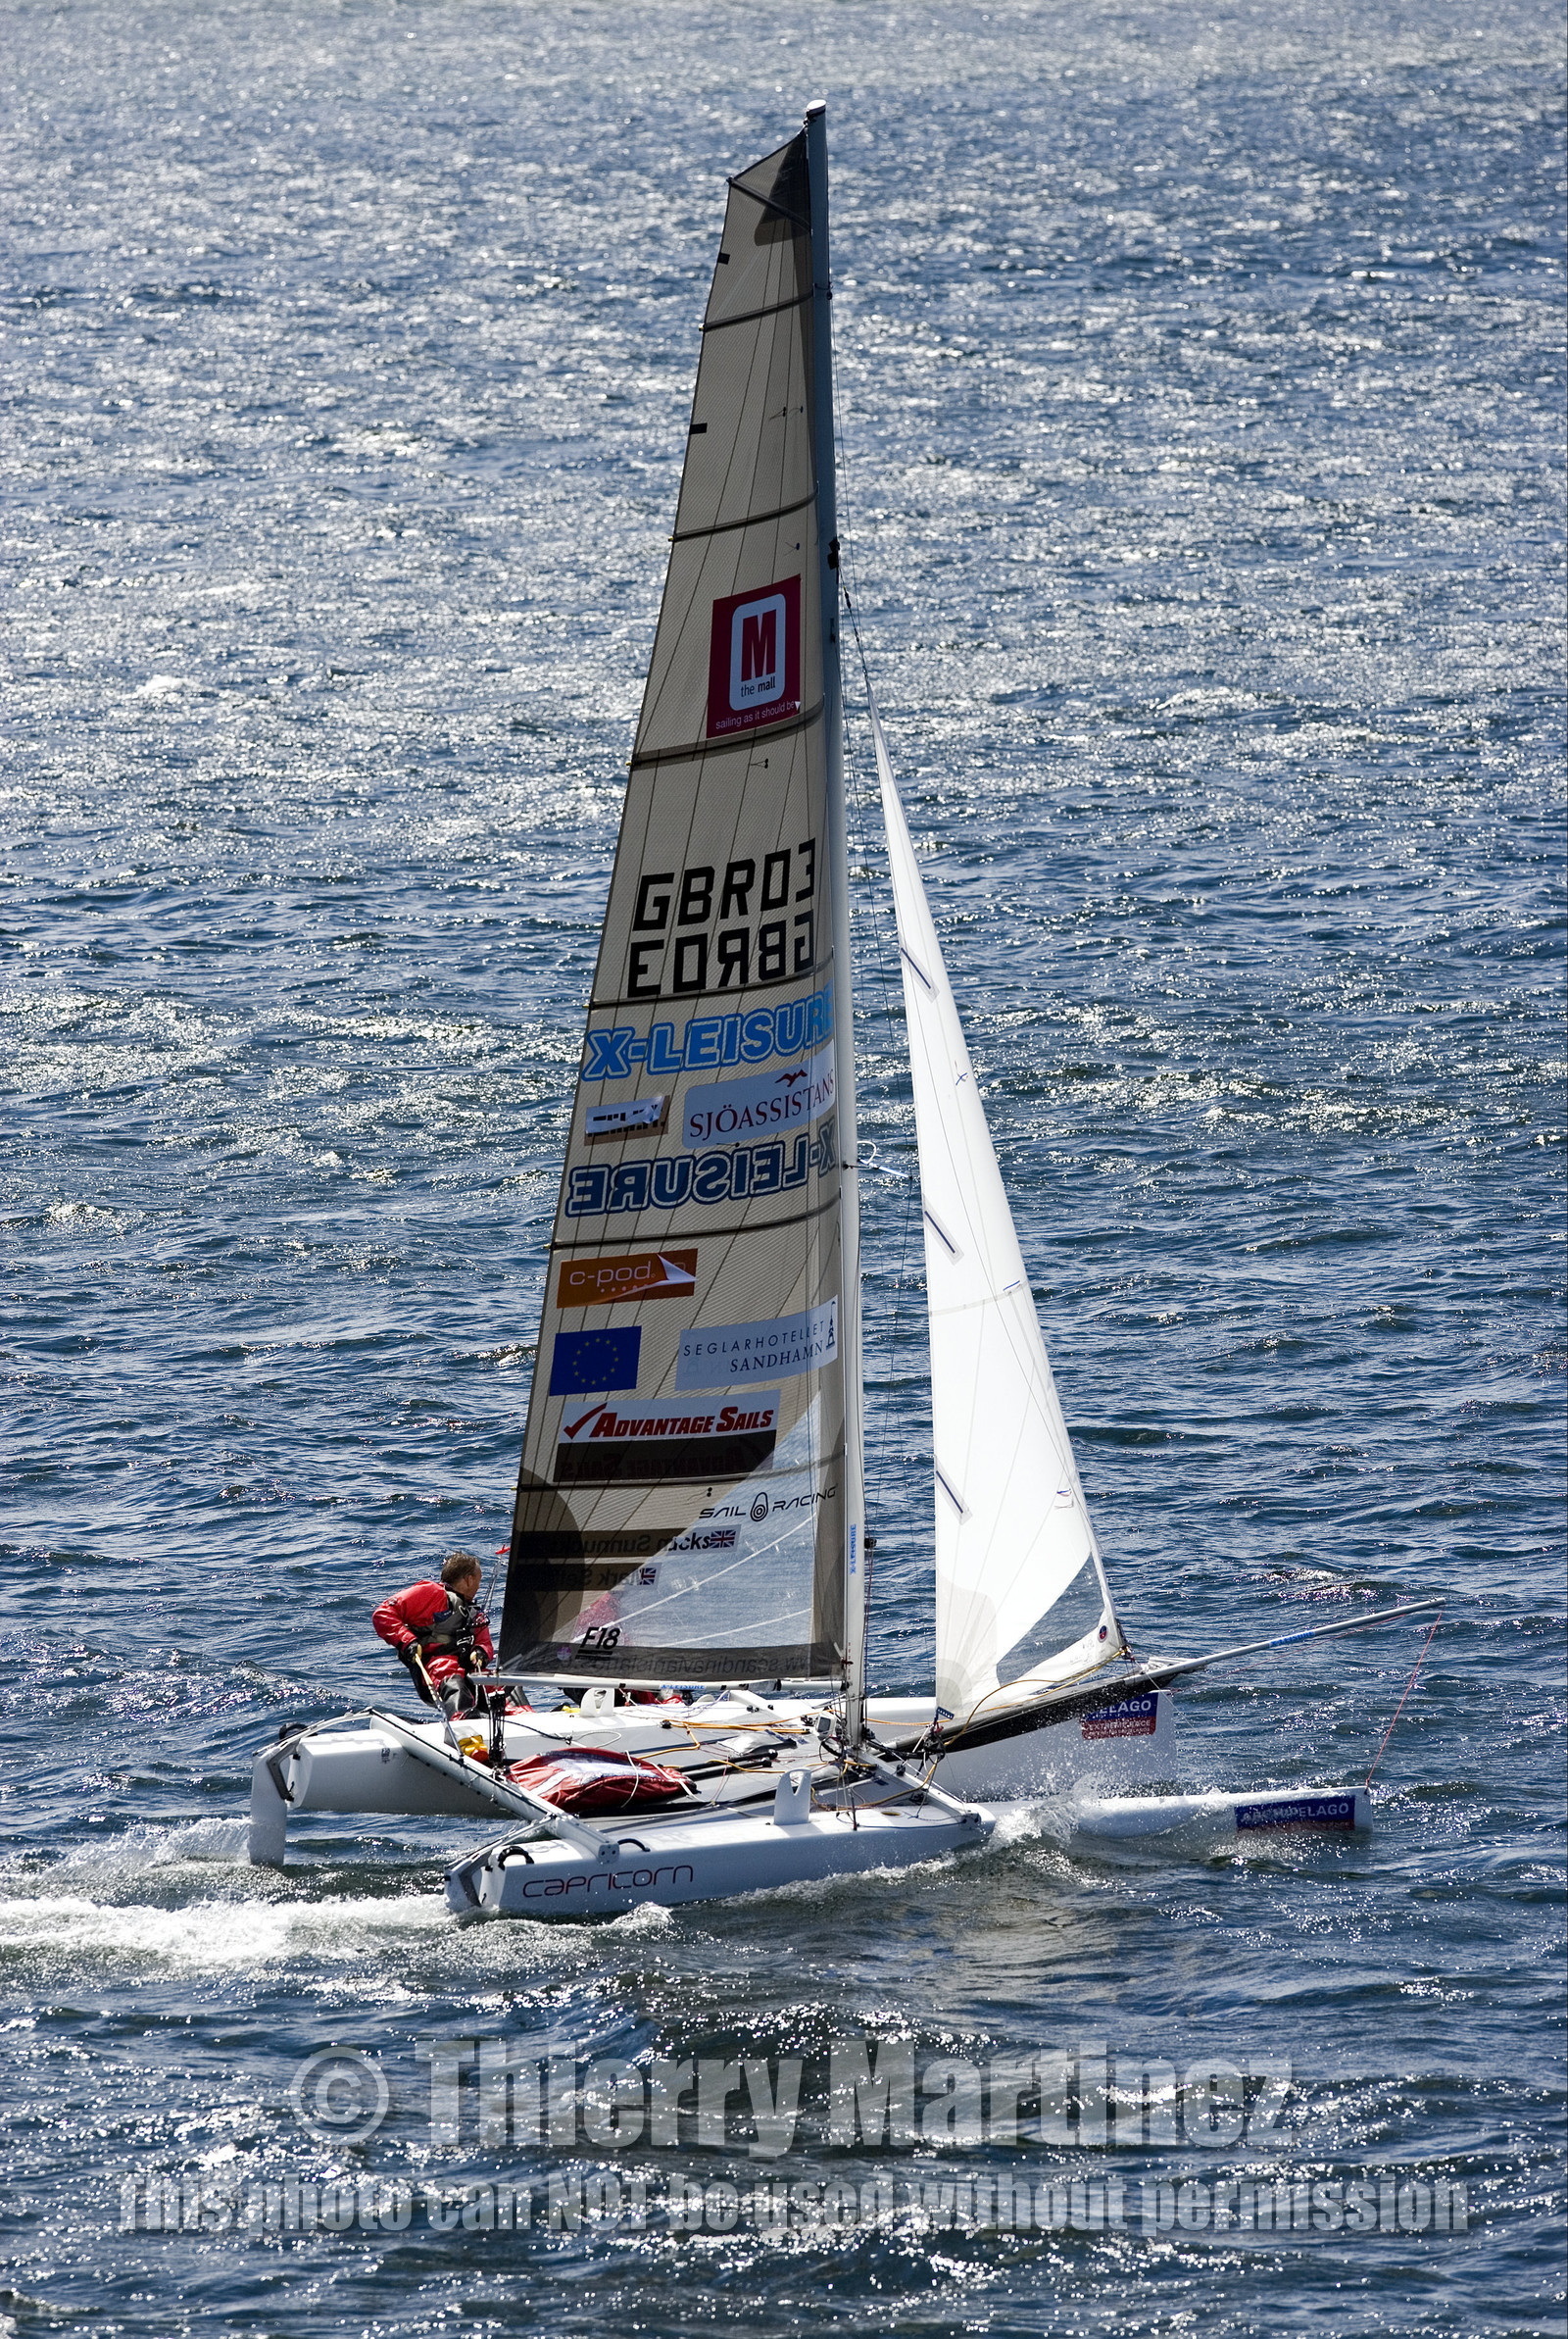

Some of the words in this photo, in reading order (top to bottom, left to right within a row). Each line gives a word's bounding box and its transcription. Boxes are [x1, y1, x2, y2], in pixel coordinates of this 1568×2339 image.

[741, 609, 777, 682] M
[741, 684, 755, 697] the
[758, 676, 776, 693] mall
[715, 717, 742, 729] sailing
[743, 714, 754, 723] as
[755, 710, 760, 721] it
[761, 702, 785, 719] should
[683, 1320, 825, 1357] SEGLARHOTELLET
[730, 1340, 824, 1373] SANDHAMN
[589, 1412, 715, 1438] ADVANTAGE
[715, 1406, 774, 1432] SAILS
[699, 1505, 747, 1518] SAIL
[772, 1484, 839, 1513] RACING
[580, 1627, 621, 1650] F18
